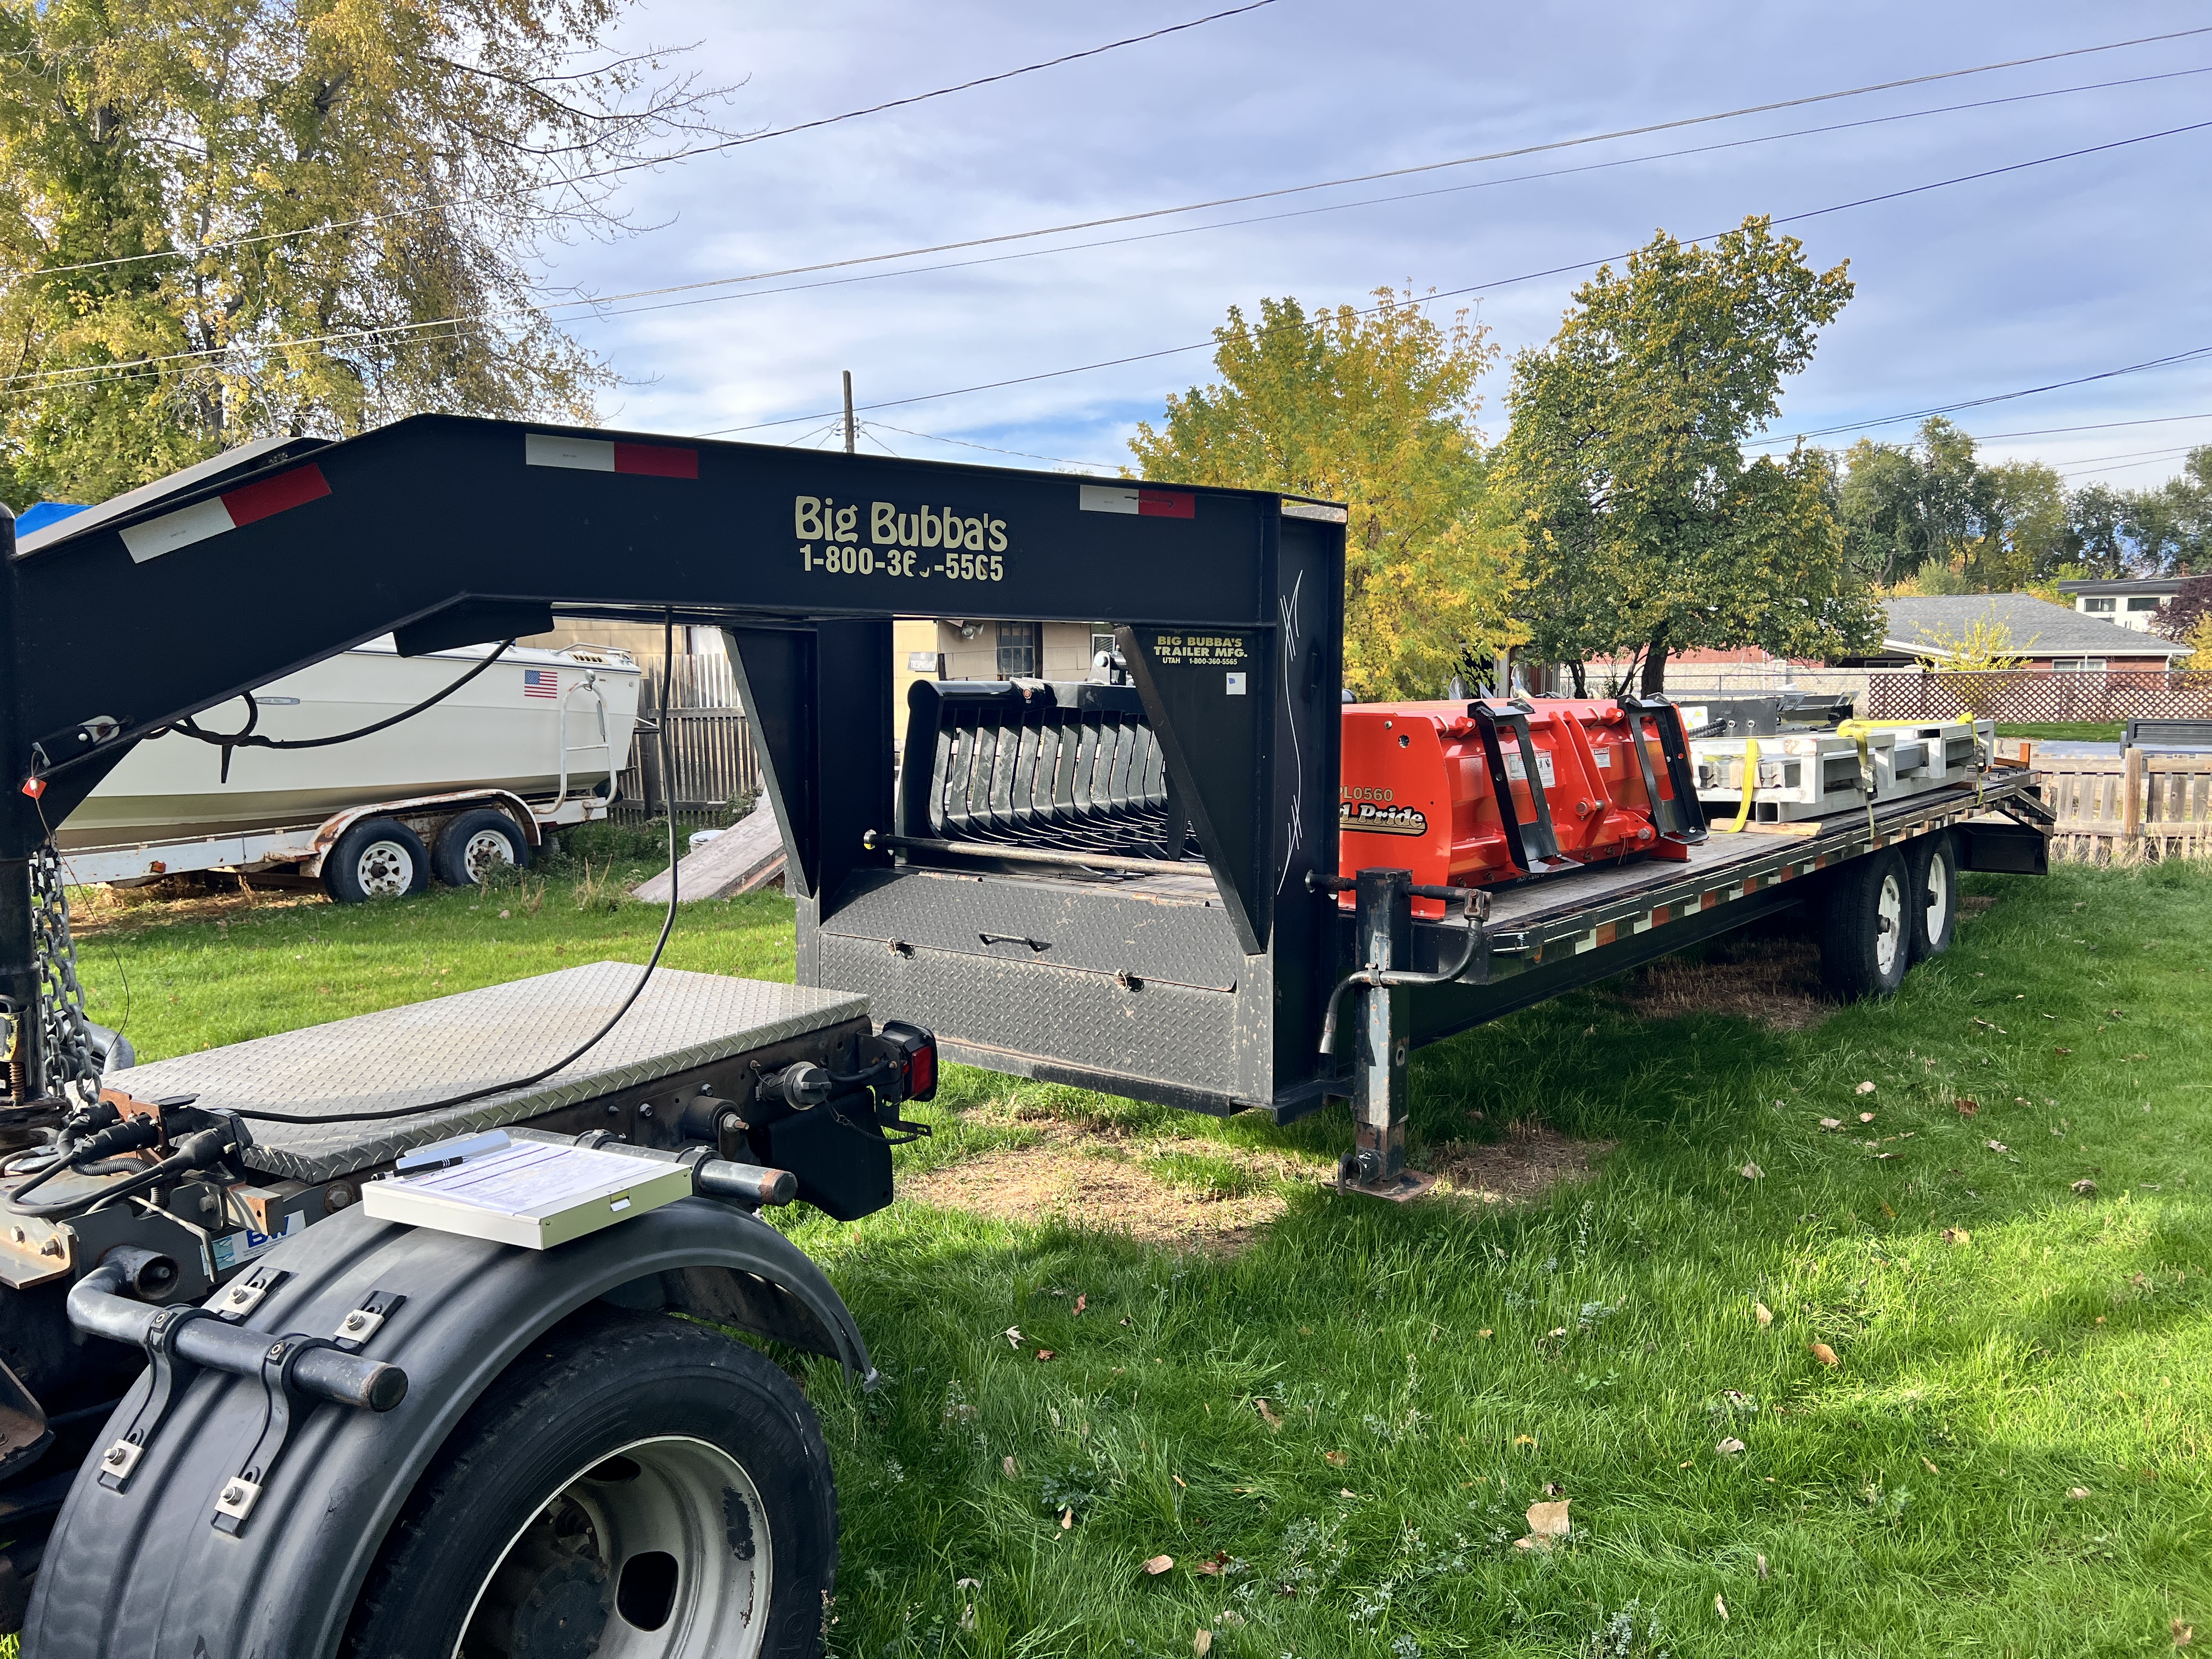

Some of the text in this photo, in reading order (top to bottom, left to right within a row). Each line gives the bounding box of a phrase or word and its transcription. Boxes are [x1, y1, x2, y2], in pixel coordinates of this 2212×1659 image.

[795, 495, 1008, 552] Big Bubba's
[800, 544, 1004, 582] 1-800-36-5565
[1154, 646, 1248, 658] TRAILER MFG.
[1158, 636, 1243, 647] BIG BUBBA'S
[1357, 805, 1424, 827] Pride
